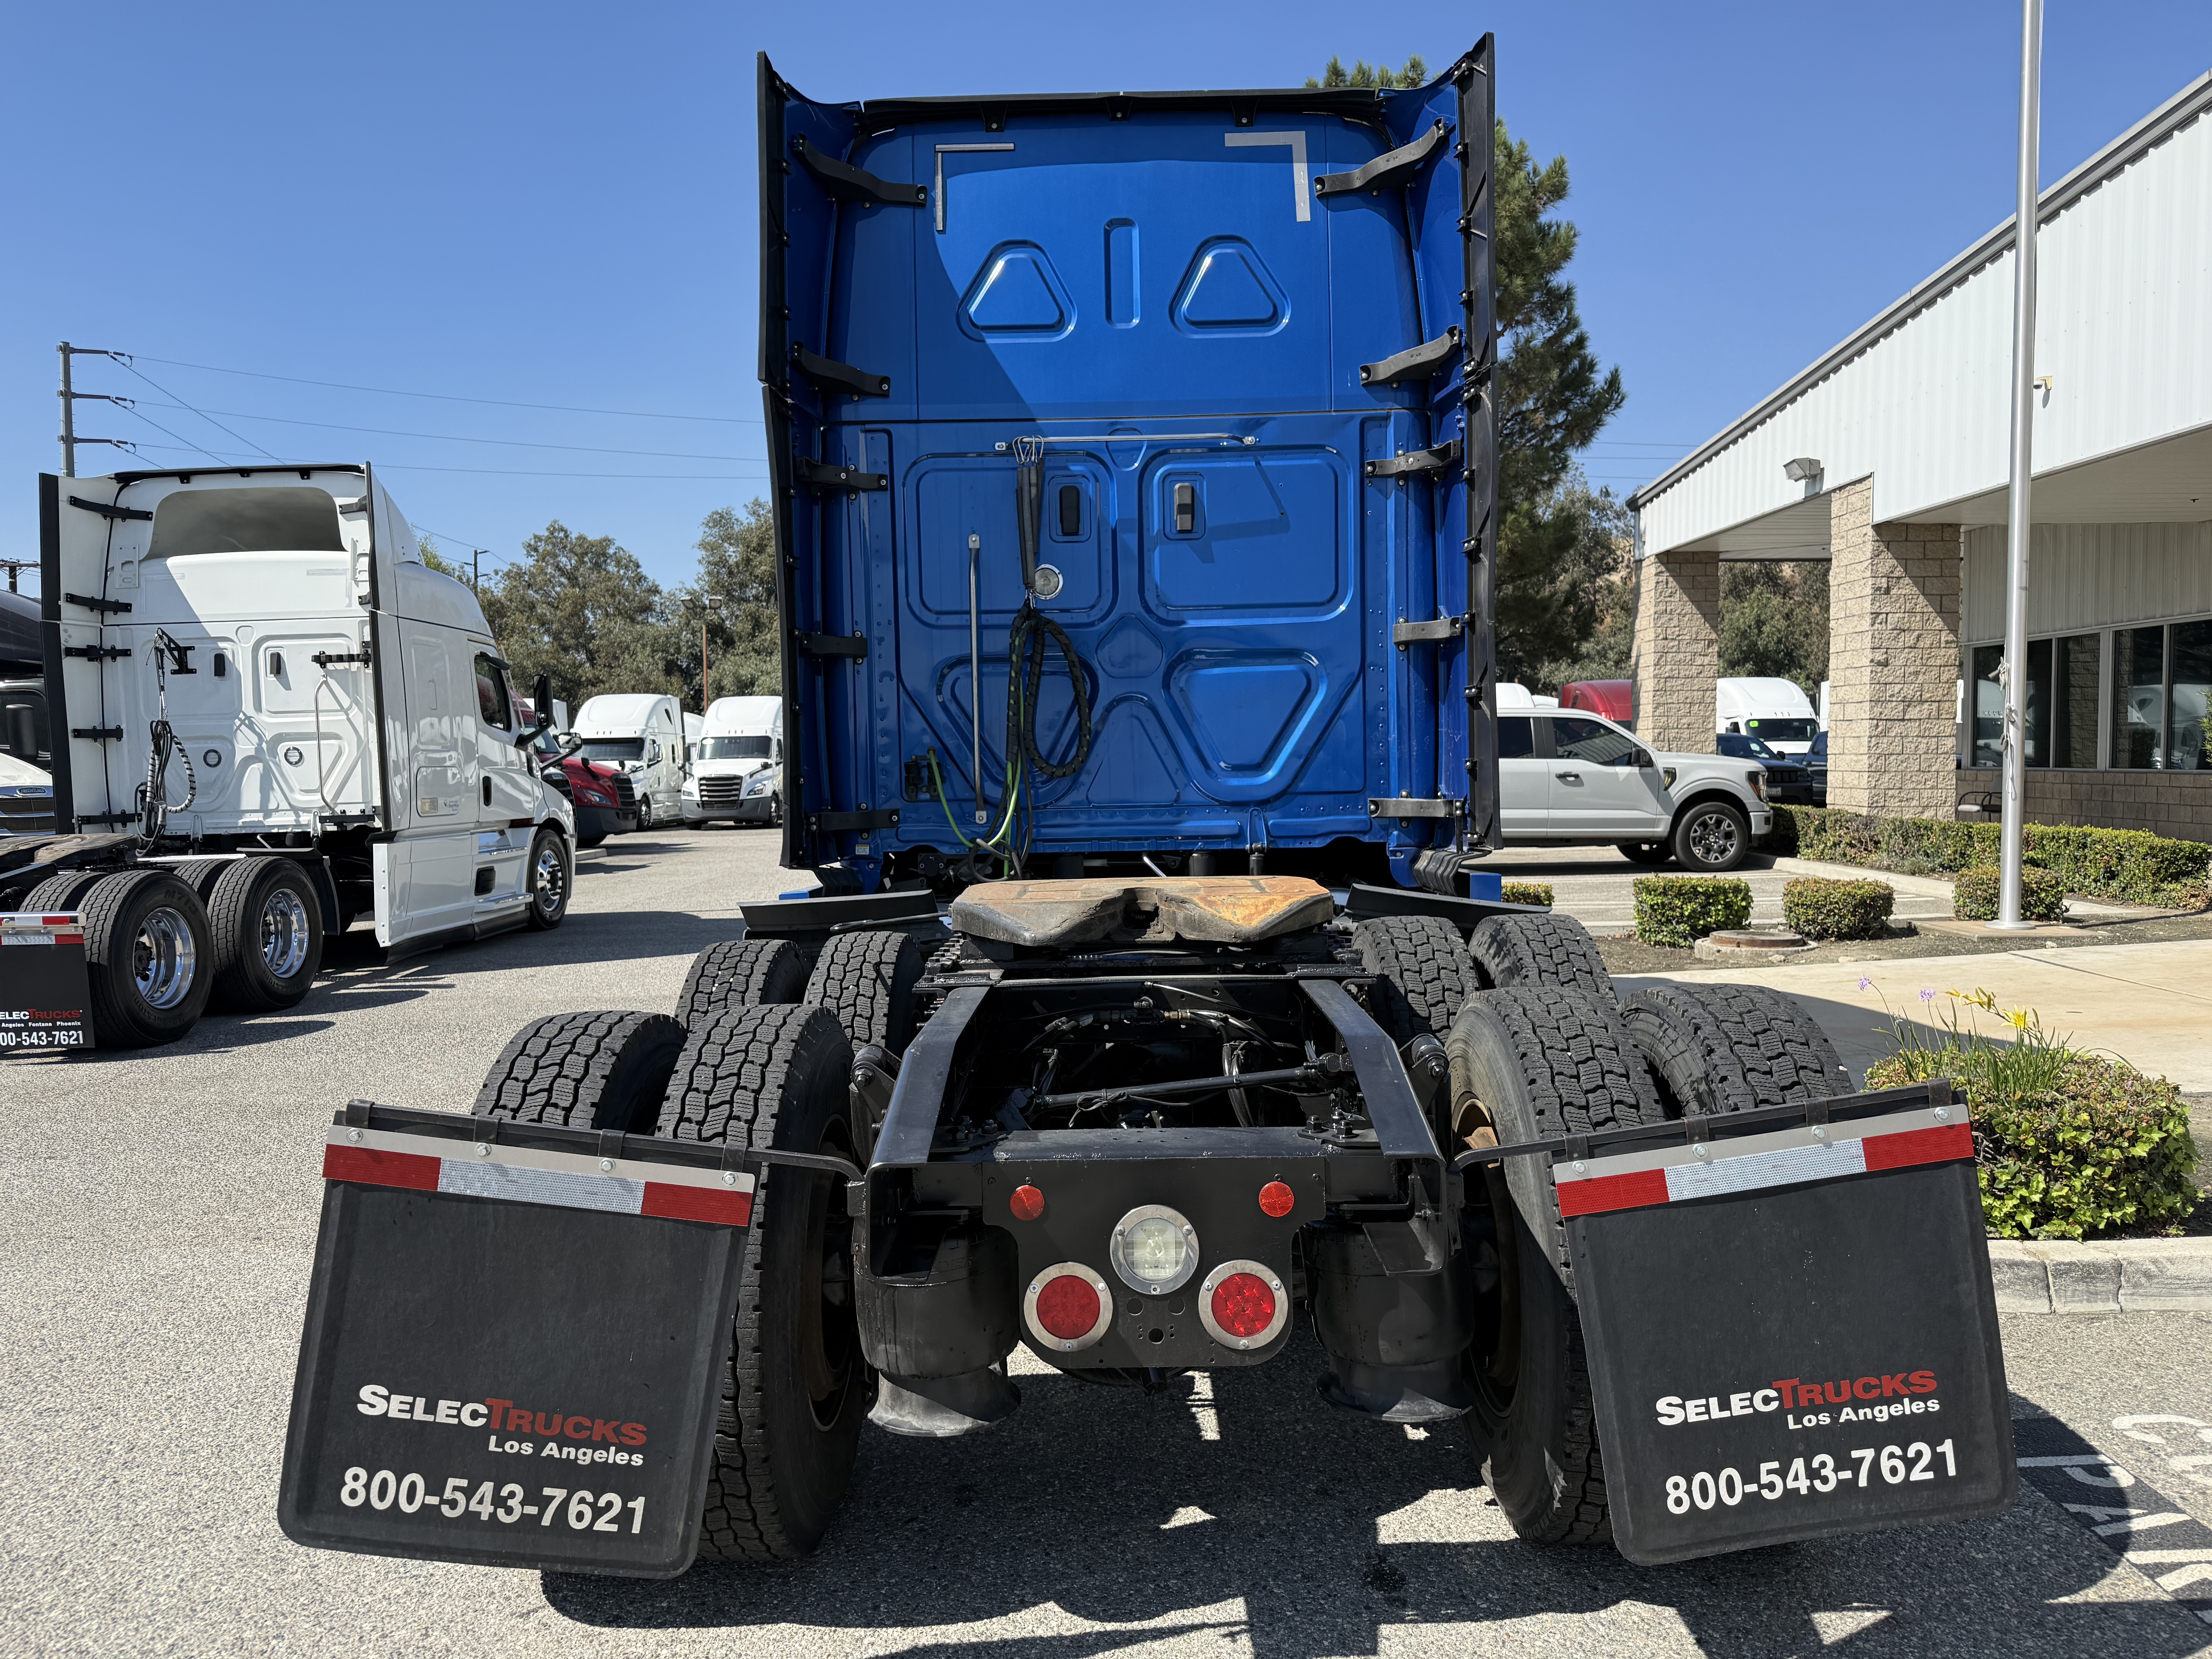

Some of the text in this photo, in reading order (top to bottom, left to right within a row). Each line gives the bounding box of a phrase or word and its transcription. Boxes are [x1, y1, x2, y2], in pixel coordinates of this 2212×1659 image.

[0, 1009, 81, 1020] ELECTRUCKS
[0, 1030, 84, 1046] 00-543-7621
[357, 1384, 647, 1446] SELECTRUCKS
[1656, 1370, 1937, 1425] SELECTRUCKS
[1788, 1398, 1940, 1429] Los Angeles
[488, 1435, 644, 1466] Los Angeles
[1666, 1439, 1956, 1515] 800-543-7621
[340, 1467, 646, 1534] 800-543-7621
